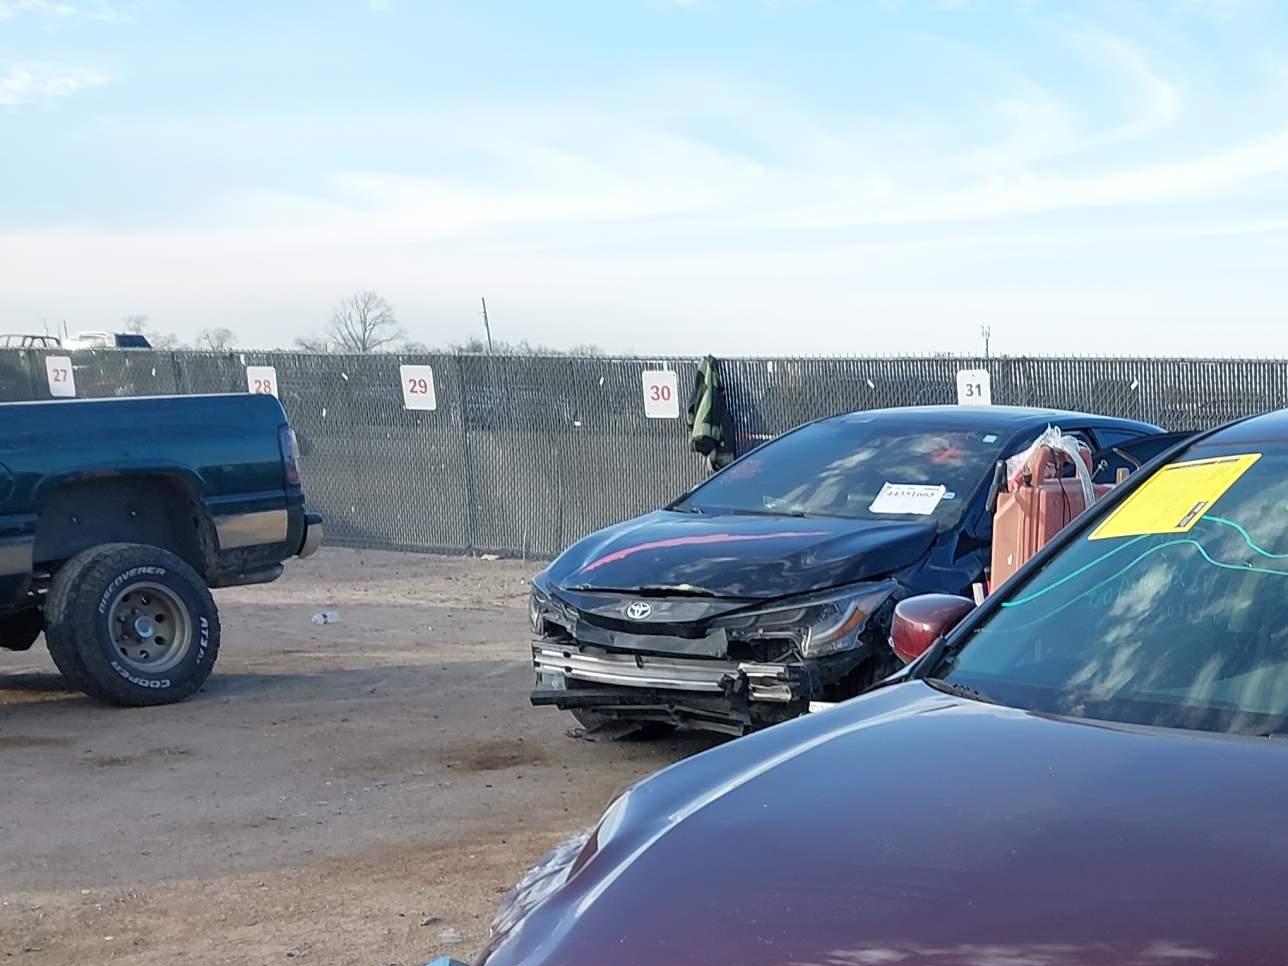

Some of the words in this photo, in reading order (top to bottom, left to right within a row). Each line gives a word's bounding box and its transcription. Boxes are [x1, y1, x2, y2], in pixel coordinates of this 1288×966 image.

[52, 368, 67, 382] 27
[254, 379, 272, 393] 28
[408, 378, 428, 394] 29
[650, 384, 671, 401] 30
[965, 383, 982, 397] 31
[98, 566, 166, 614] DISCOVERER
[111, 660, 171, 689] COOPER
